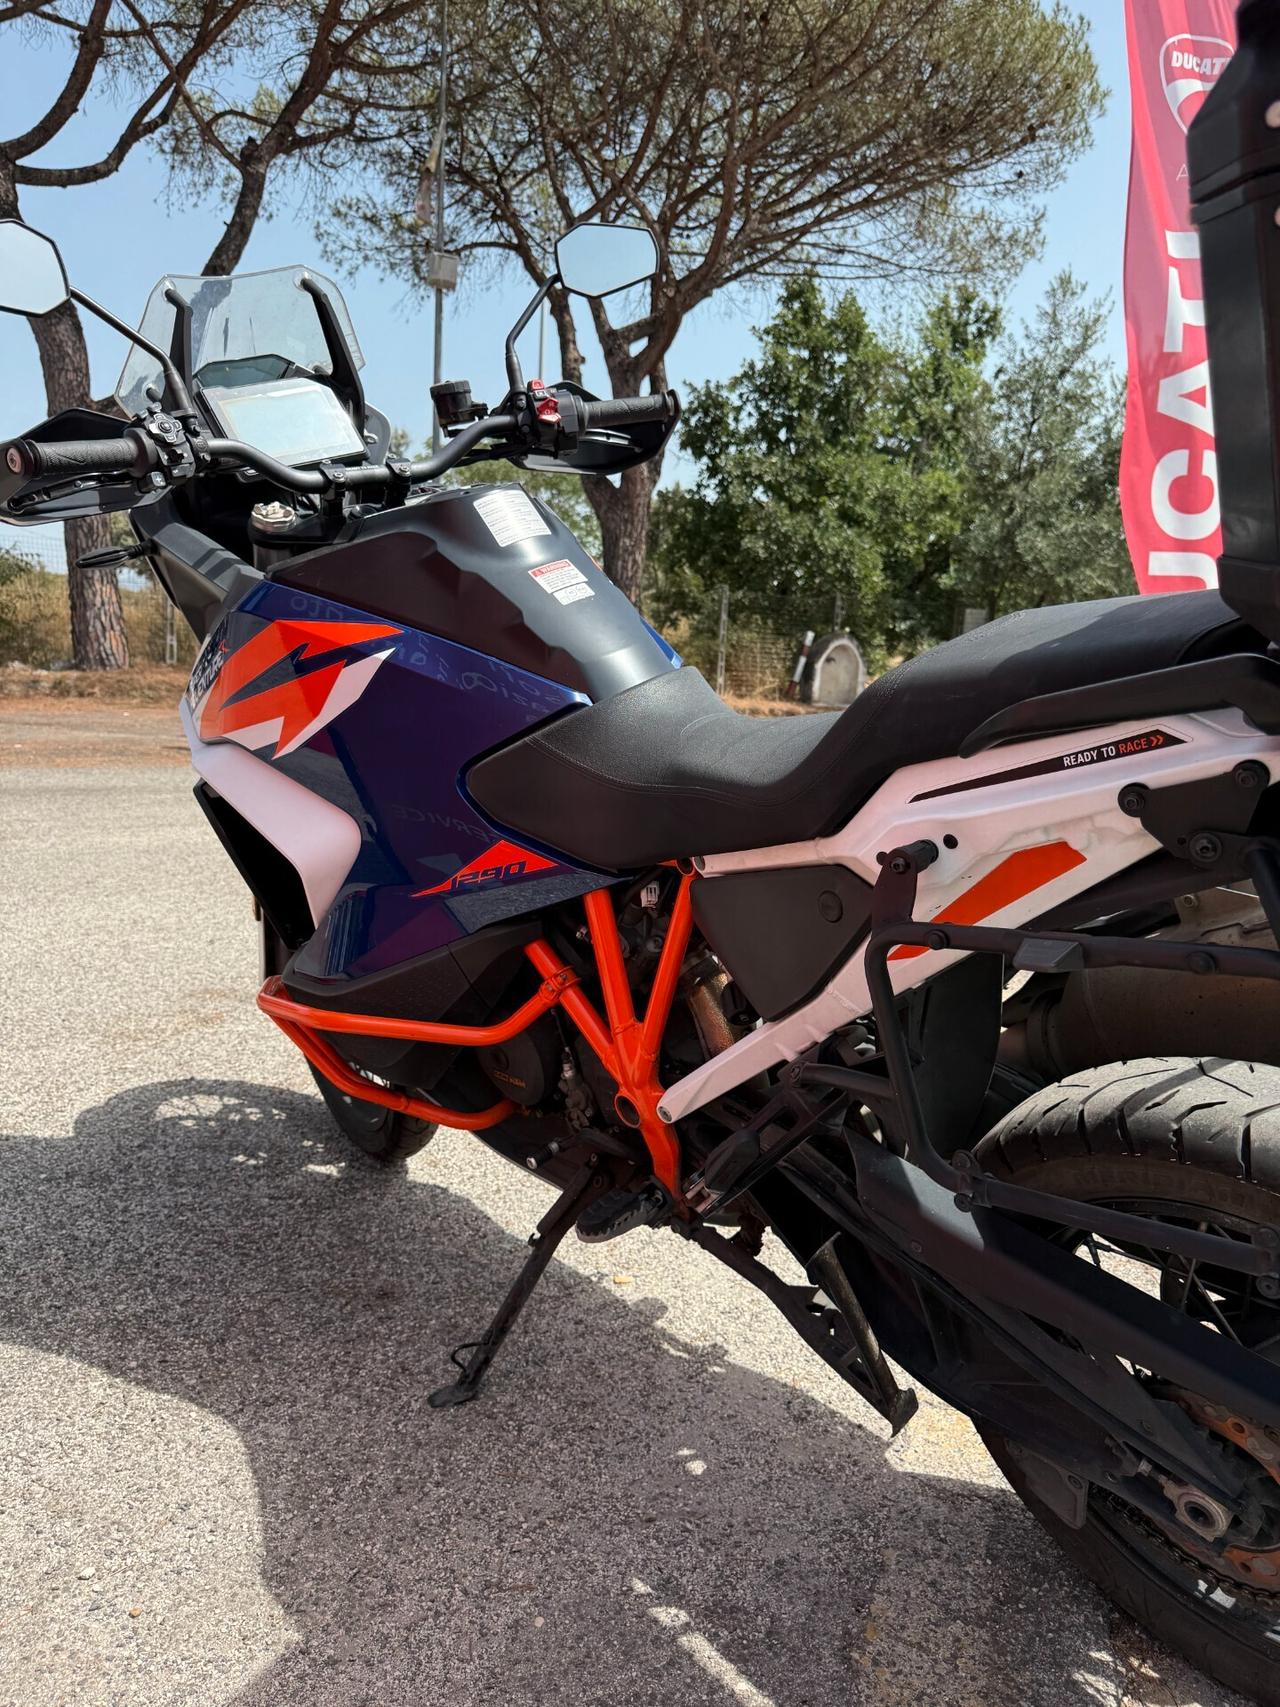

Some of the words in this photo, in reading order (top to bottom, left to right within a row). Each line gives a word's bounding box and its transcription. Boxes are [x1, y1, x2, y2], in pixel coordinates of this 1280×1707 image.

[1147, 229, 1221, 590] UCATI
[1063, 749, 1098, 767] READY
[1101, 746, 1116, 758] TO
[1118, 737, 1148, 755] RACE
